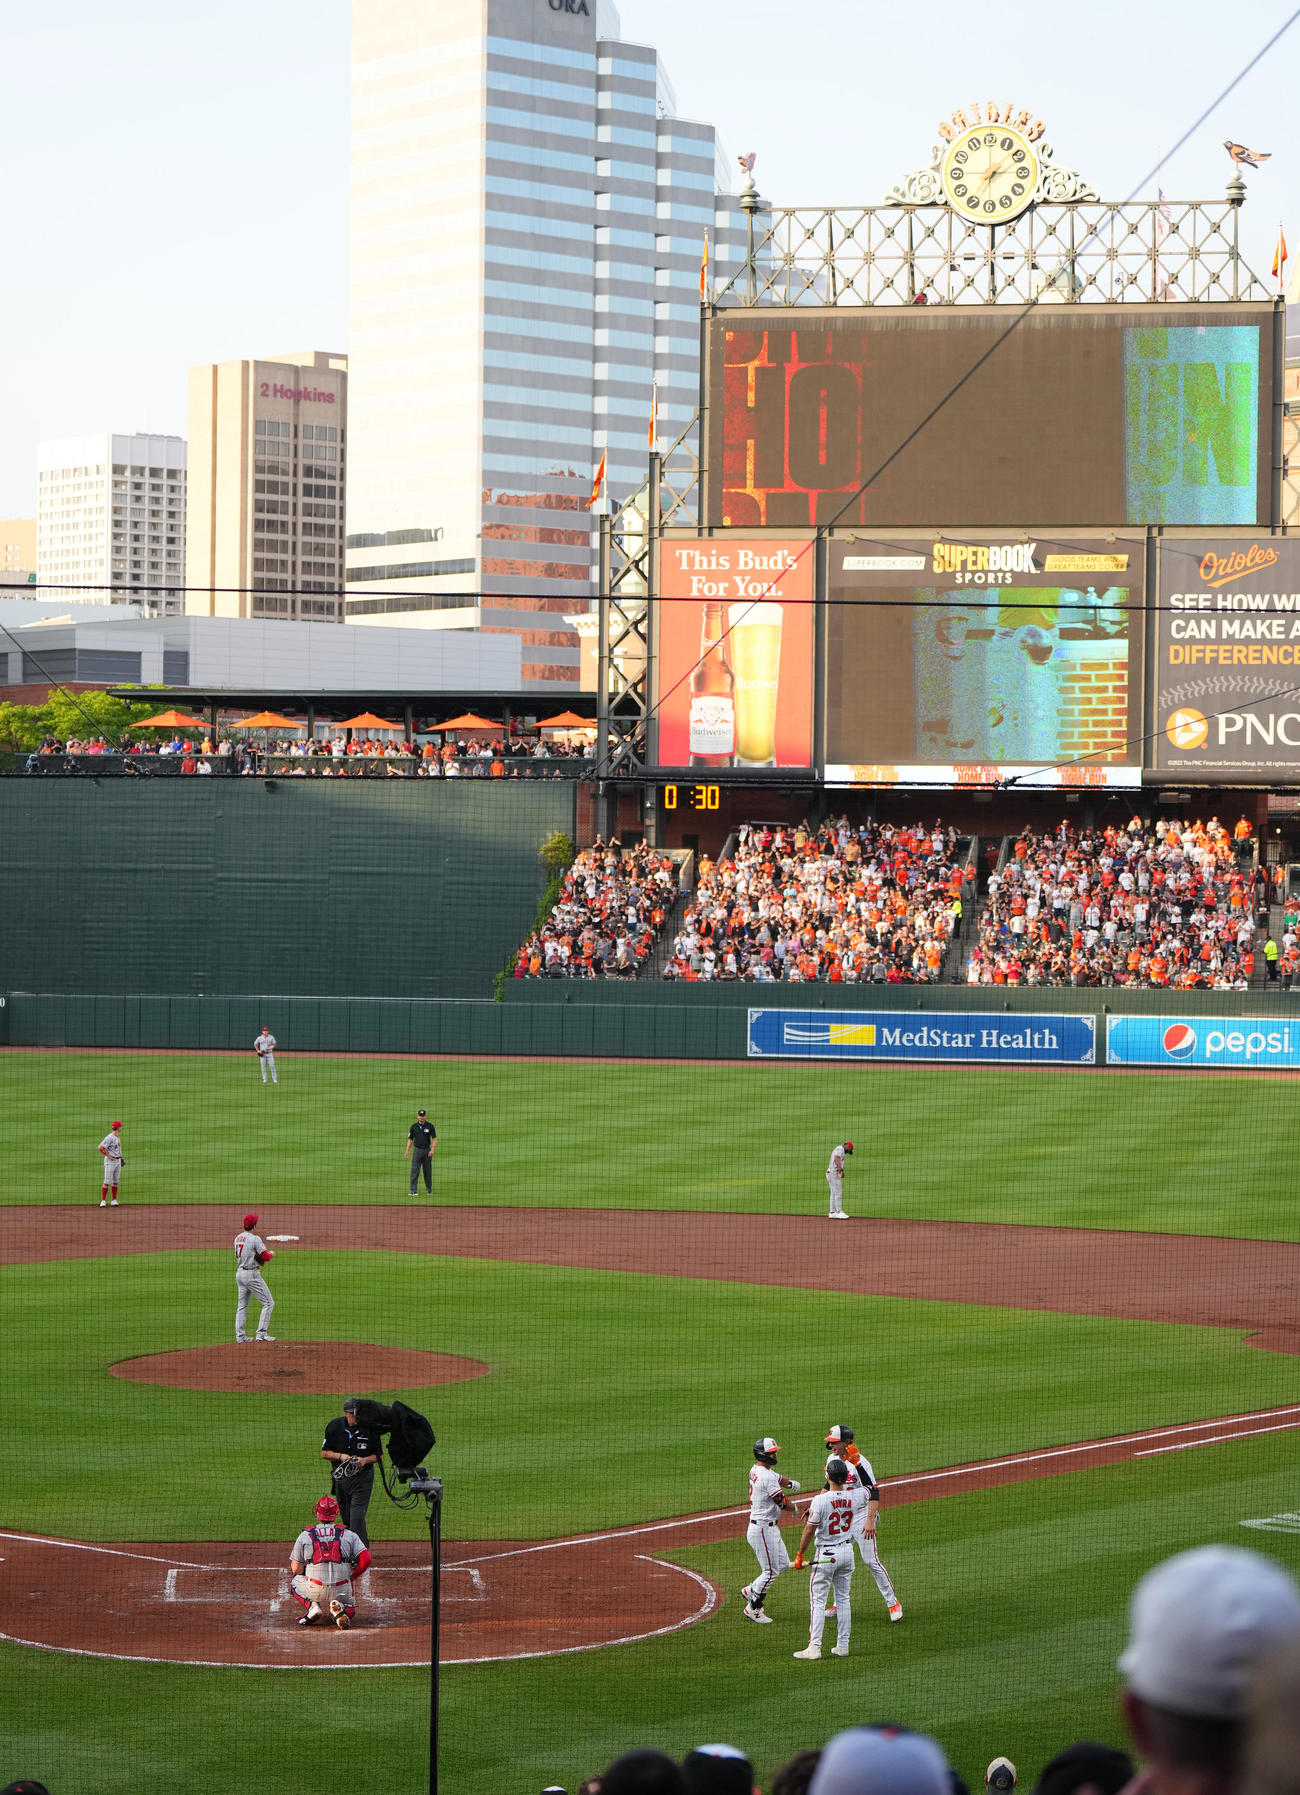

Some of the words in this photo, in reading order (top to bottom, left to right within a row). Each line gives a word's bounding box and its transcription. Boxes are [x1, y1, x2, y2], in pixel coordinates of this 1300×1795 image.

[938, 101, 1046, 144] ORIOLES
[260, 382, 270, 398] 2
[273, 383, 336, 404] Hopkins
[675, 549, 730, 570] This
[736, 549, 798, 570] Bud's
[932, 543, 1037, 574] SUPERBOOK
[1199, 544, 1278, 586] Orioles
[689, 576, 729, 596] For
[733, 576, 783, 596] You.
[955, 572, 1013, 584] SPORTS
[1170, 594, 1212, 613] SEE
[1217, 594, 1269, 613] HOW
[1171, 620, 1216, 639] CAN
[1222, 620, 1286, 639] MAKE
[1215, 713, 1300, 746] PNC
[664, 785, 677, 809] 0
[881, 1027, 975, 1047] MedStar
[980, 1028, 1059, 1048] Health
[829, 1510, 853, 1535] 23
